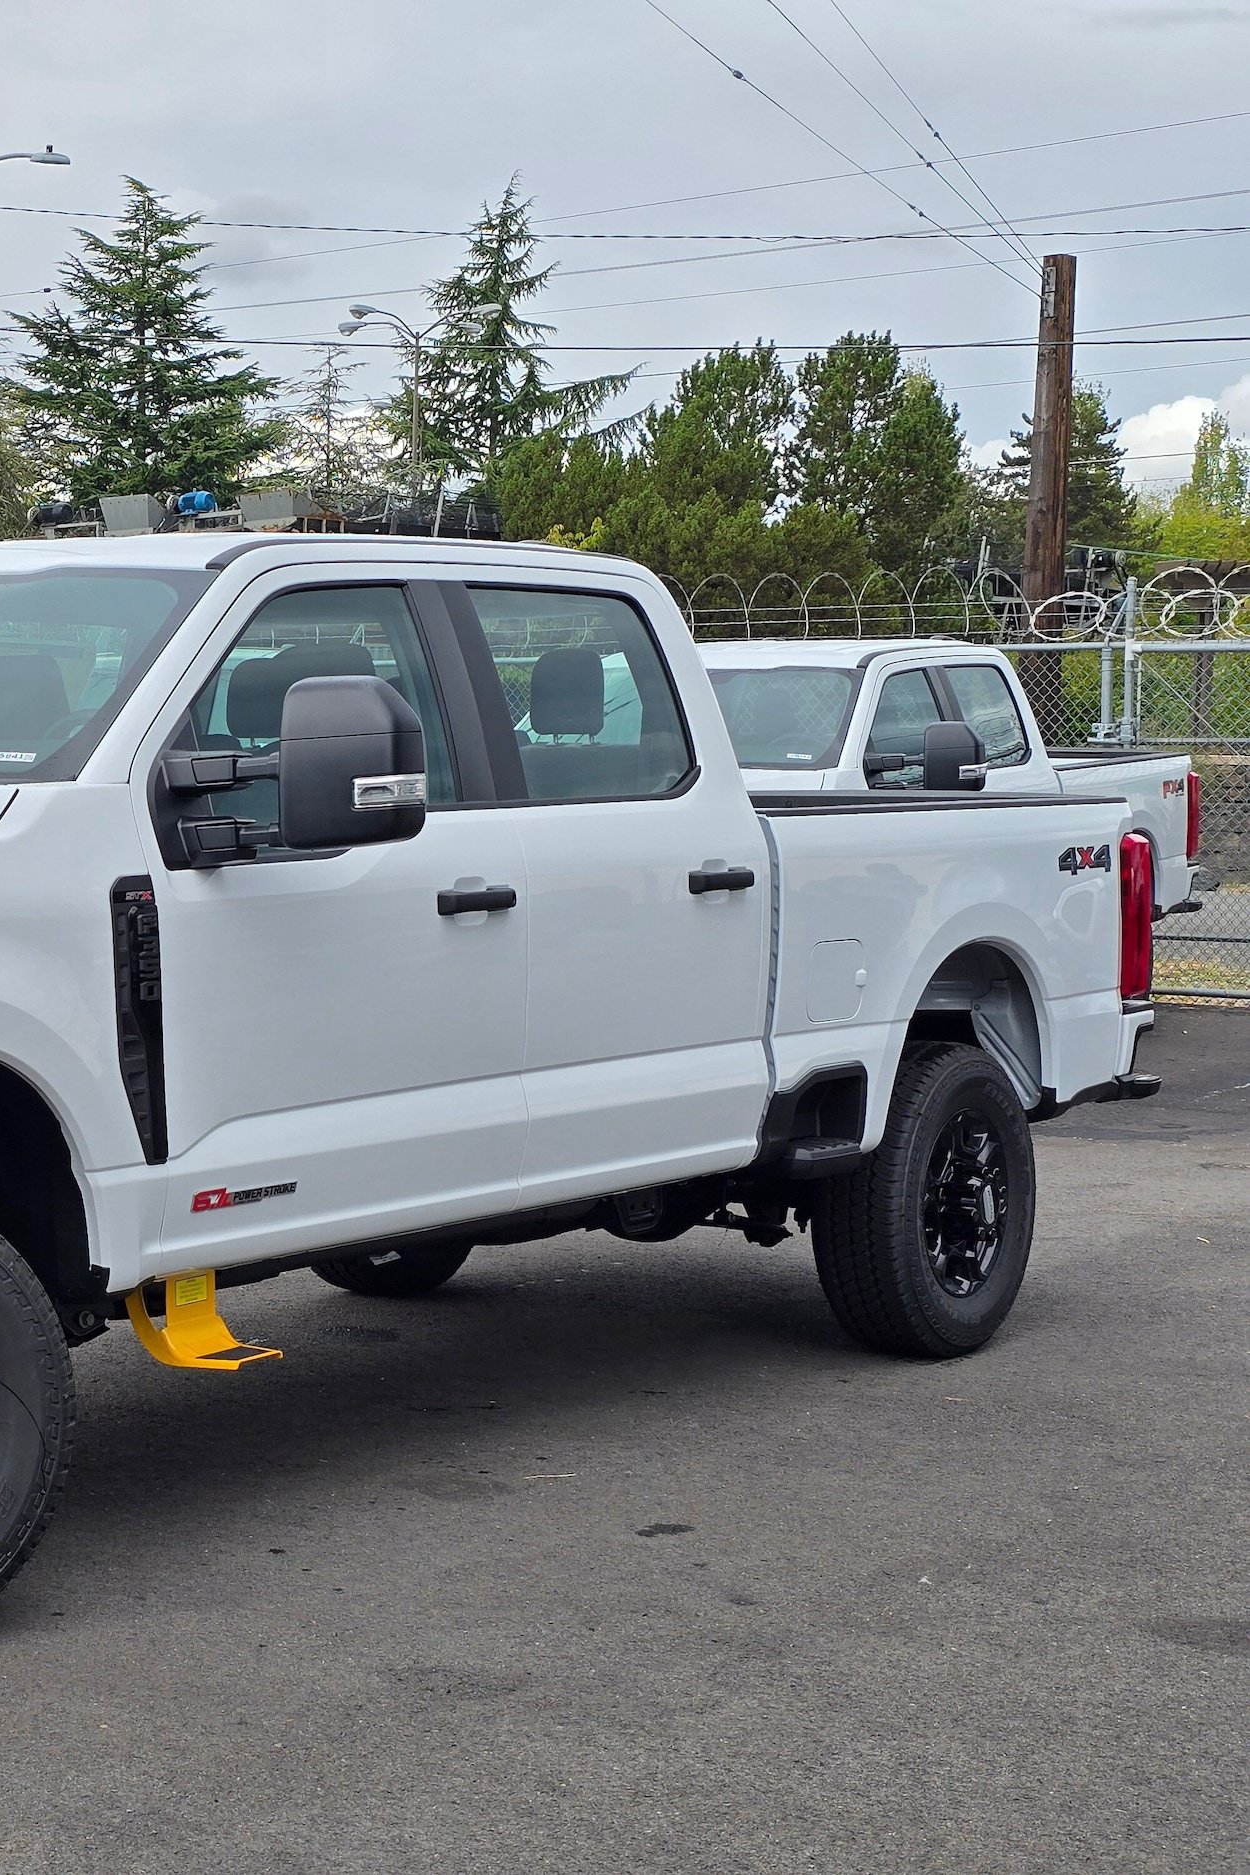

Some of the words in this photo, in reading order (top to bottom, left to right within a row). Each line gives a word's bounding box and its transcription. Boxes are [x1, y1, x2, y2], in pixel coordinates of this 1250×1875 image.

[1162, 778, 1184, 798] FX4
[233, 1188, 263, 1202] POWER
[263, 1183, 297, 1198] STROKE
